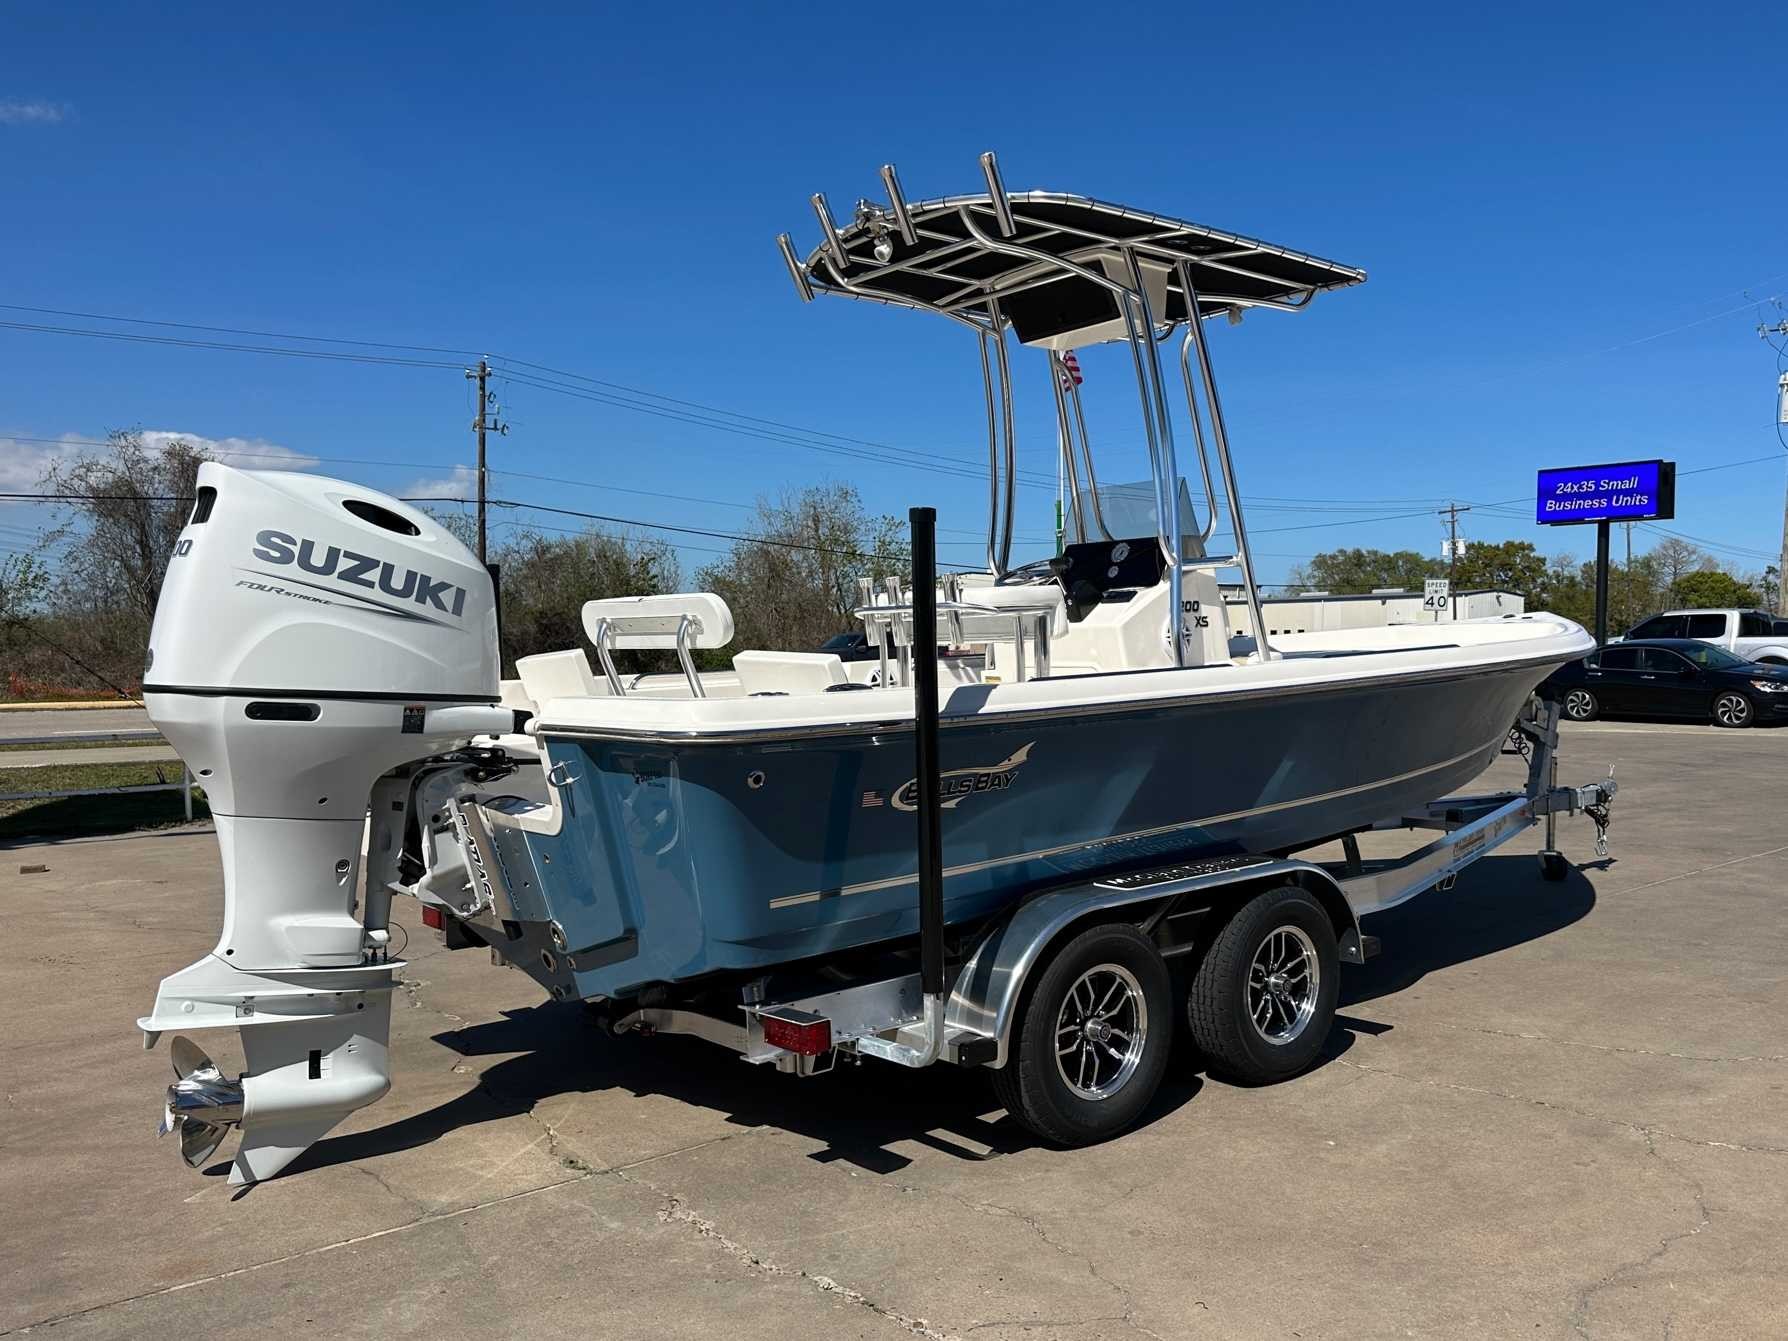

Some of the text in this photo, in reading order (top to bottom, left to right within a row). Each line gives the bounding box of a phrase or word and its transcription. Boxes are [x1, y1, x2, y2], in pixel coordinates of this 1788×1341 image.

[1556, 476, 1639, 495] 24x35 Small
[1545, 494, 1649, 512] Business Units
[252, 529, 467, 617] SUZUKI
[1425, 595, 1447, 608] 40
[1194, 615, 1209, 627] XS
[904, 771, 1018, 803] BLLS BAY
